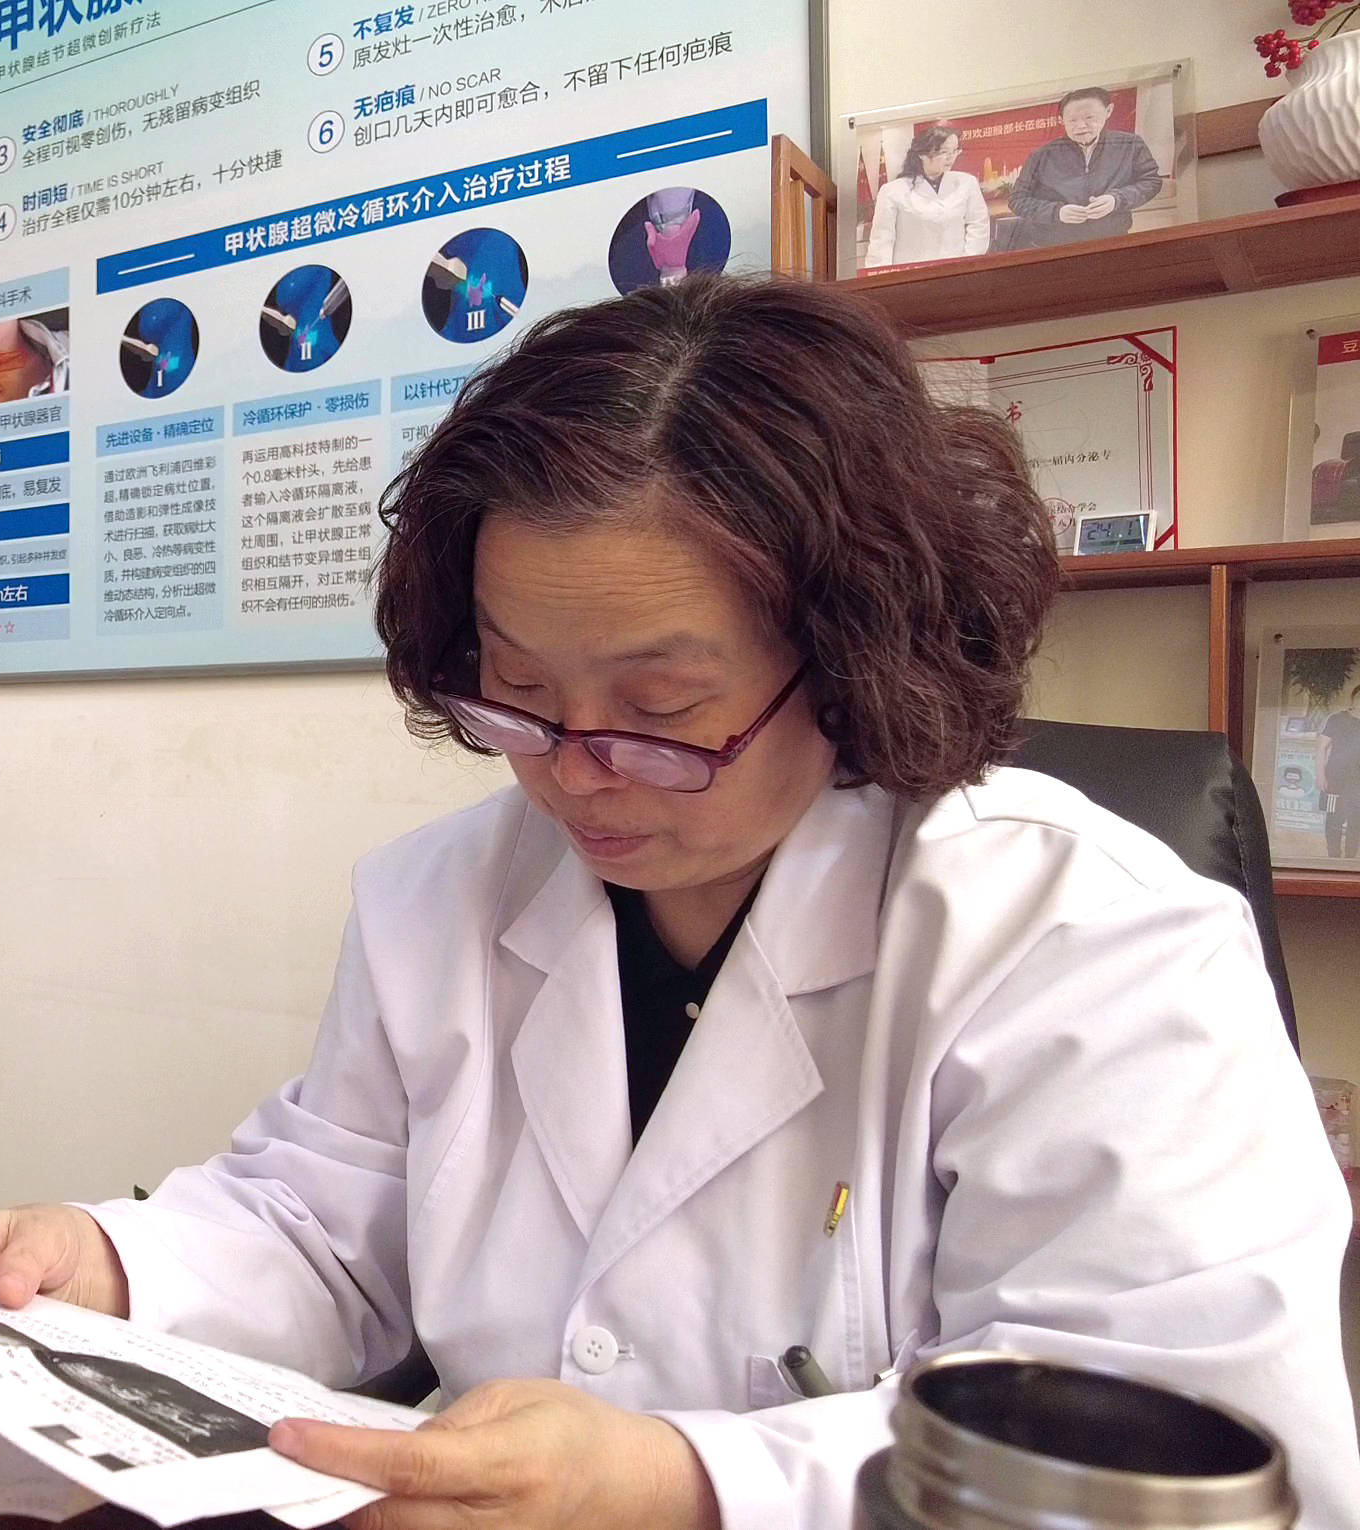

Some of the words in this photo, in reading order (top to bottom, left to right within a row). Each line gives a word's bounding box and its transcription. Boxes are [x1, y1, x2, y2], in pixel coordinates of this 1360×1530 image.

[352, 5, 415, 41] 不复发
[319, 42, 333, 68] 5
[353, 31, 733, 147] 创口几天内即可愈合，不留下任何疤痕
[353, 84, 416, 119] 无疤痕
[428, 81, 452, 98] NO
[456, 67, 500, 90] SCAR
[22, 109, 84, 144] 安全彻底
[93, 84, 179, 121] THOROUGHLY
[22, 79, 261, 168] 全程可视零创伤，无残留病变组织
[319, 120, 334, 144] 6
[22, 184, 68, 212] 时间短
[77, 180, 104, 198] TIME
[106, 174, 119, 188] IS
[121, 162, 164, 184] SHORT
[224, 154, 571, 257] 甲状腺超微冷循环介入治疗过程
[242, 436, 372, 464] 再运用高科技特制的一
[104, 456, 216, 483] 通过欧洲飞利浦四维彩
[242, 501, 371, 528] 这个隔离液会扩散至病
[241, 546, 371, 570] 组织和结节变异增生组
